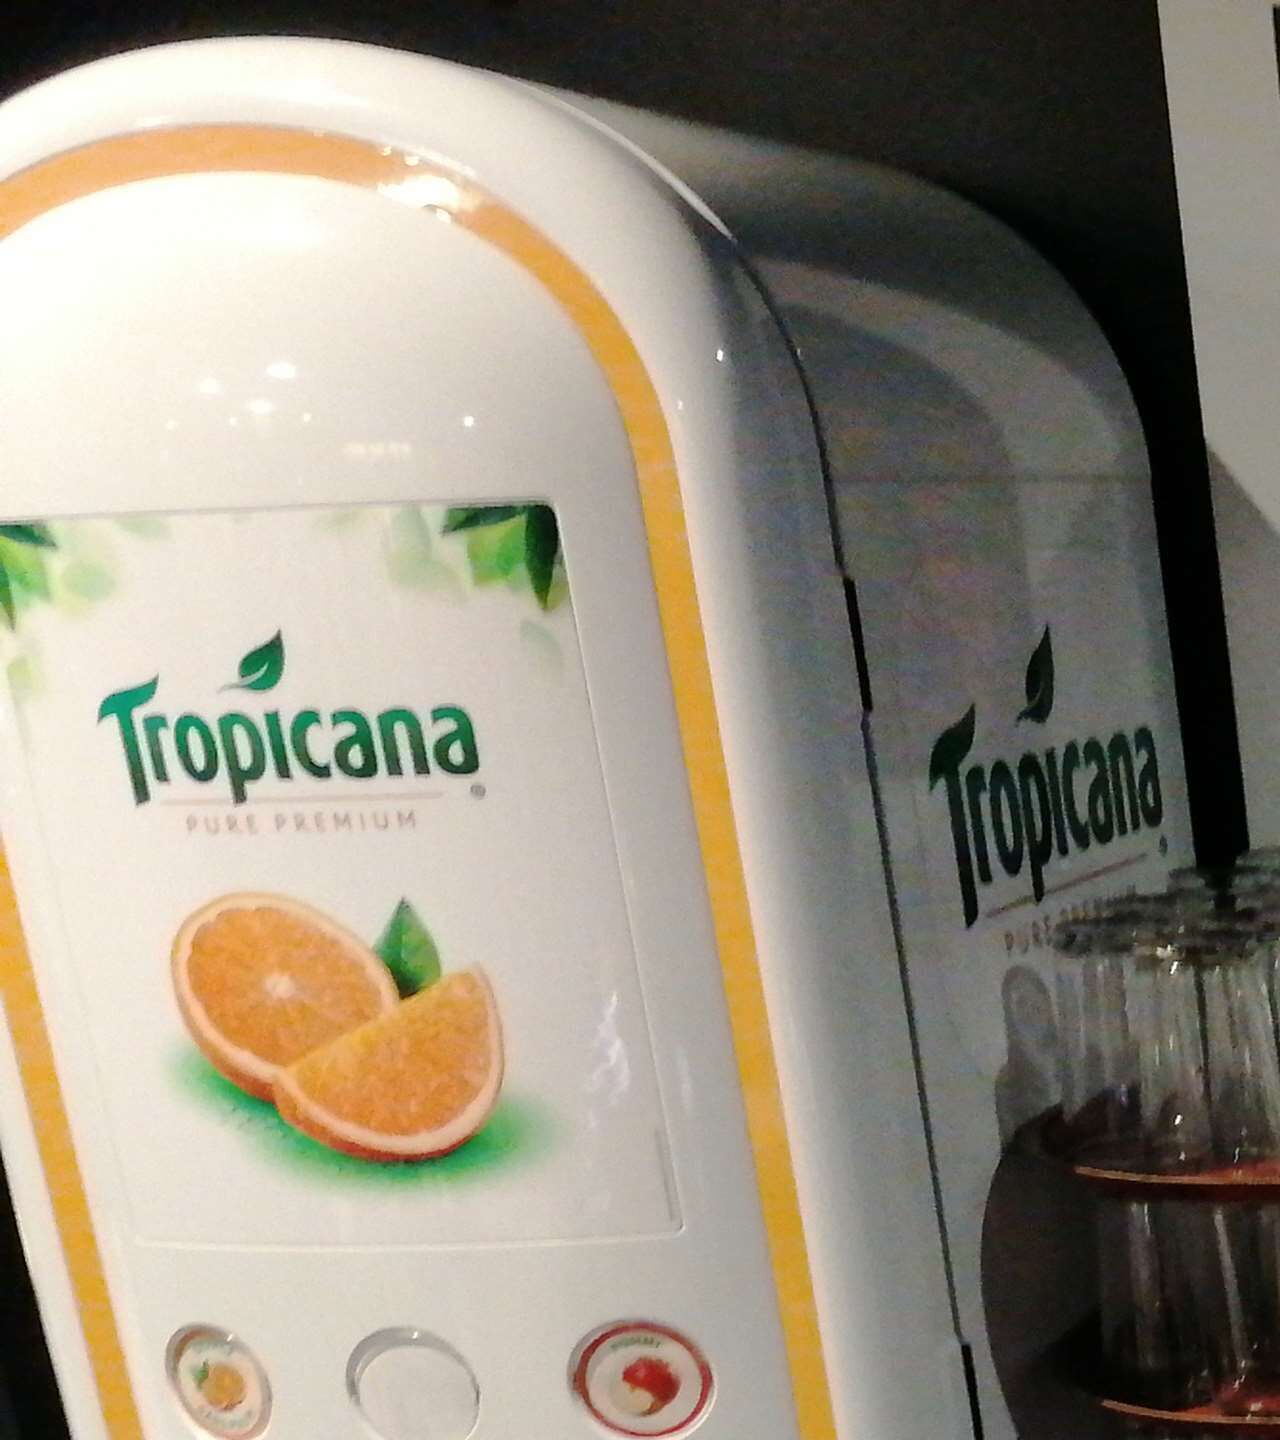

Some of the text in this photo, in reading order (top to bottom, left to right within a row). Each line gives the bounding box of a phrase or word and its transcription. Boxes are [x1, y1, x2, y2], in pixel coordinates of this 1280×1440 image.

[98, 672, 480, 808] Tropicana
[185, 808, 418, 836] PURE PREMIUM
[929, 702, 1163, 930] Tropicana
